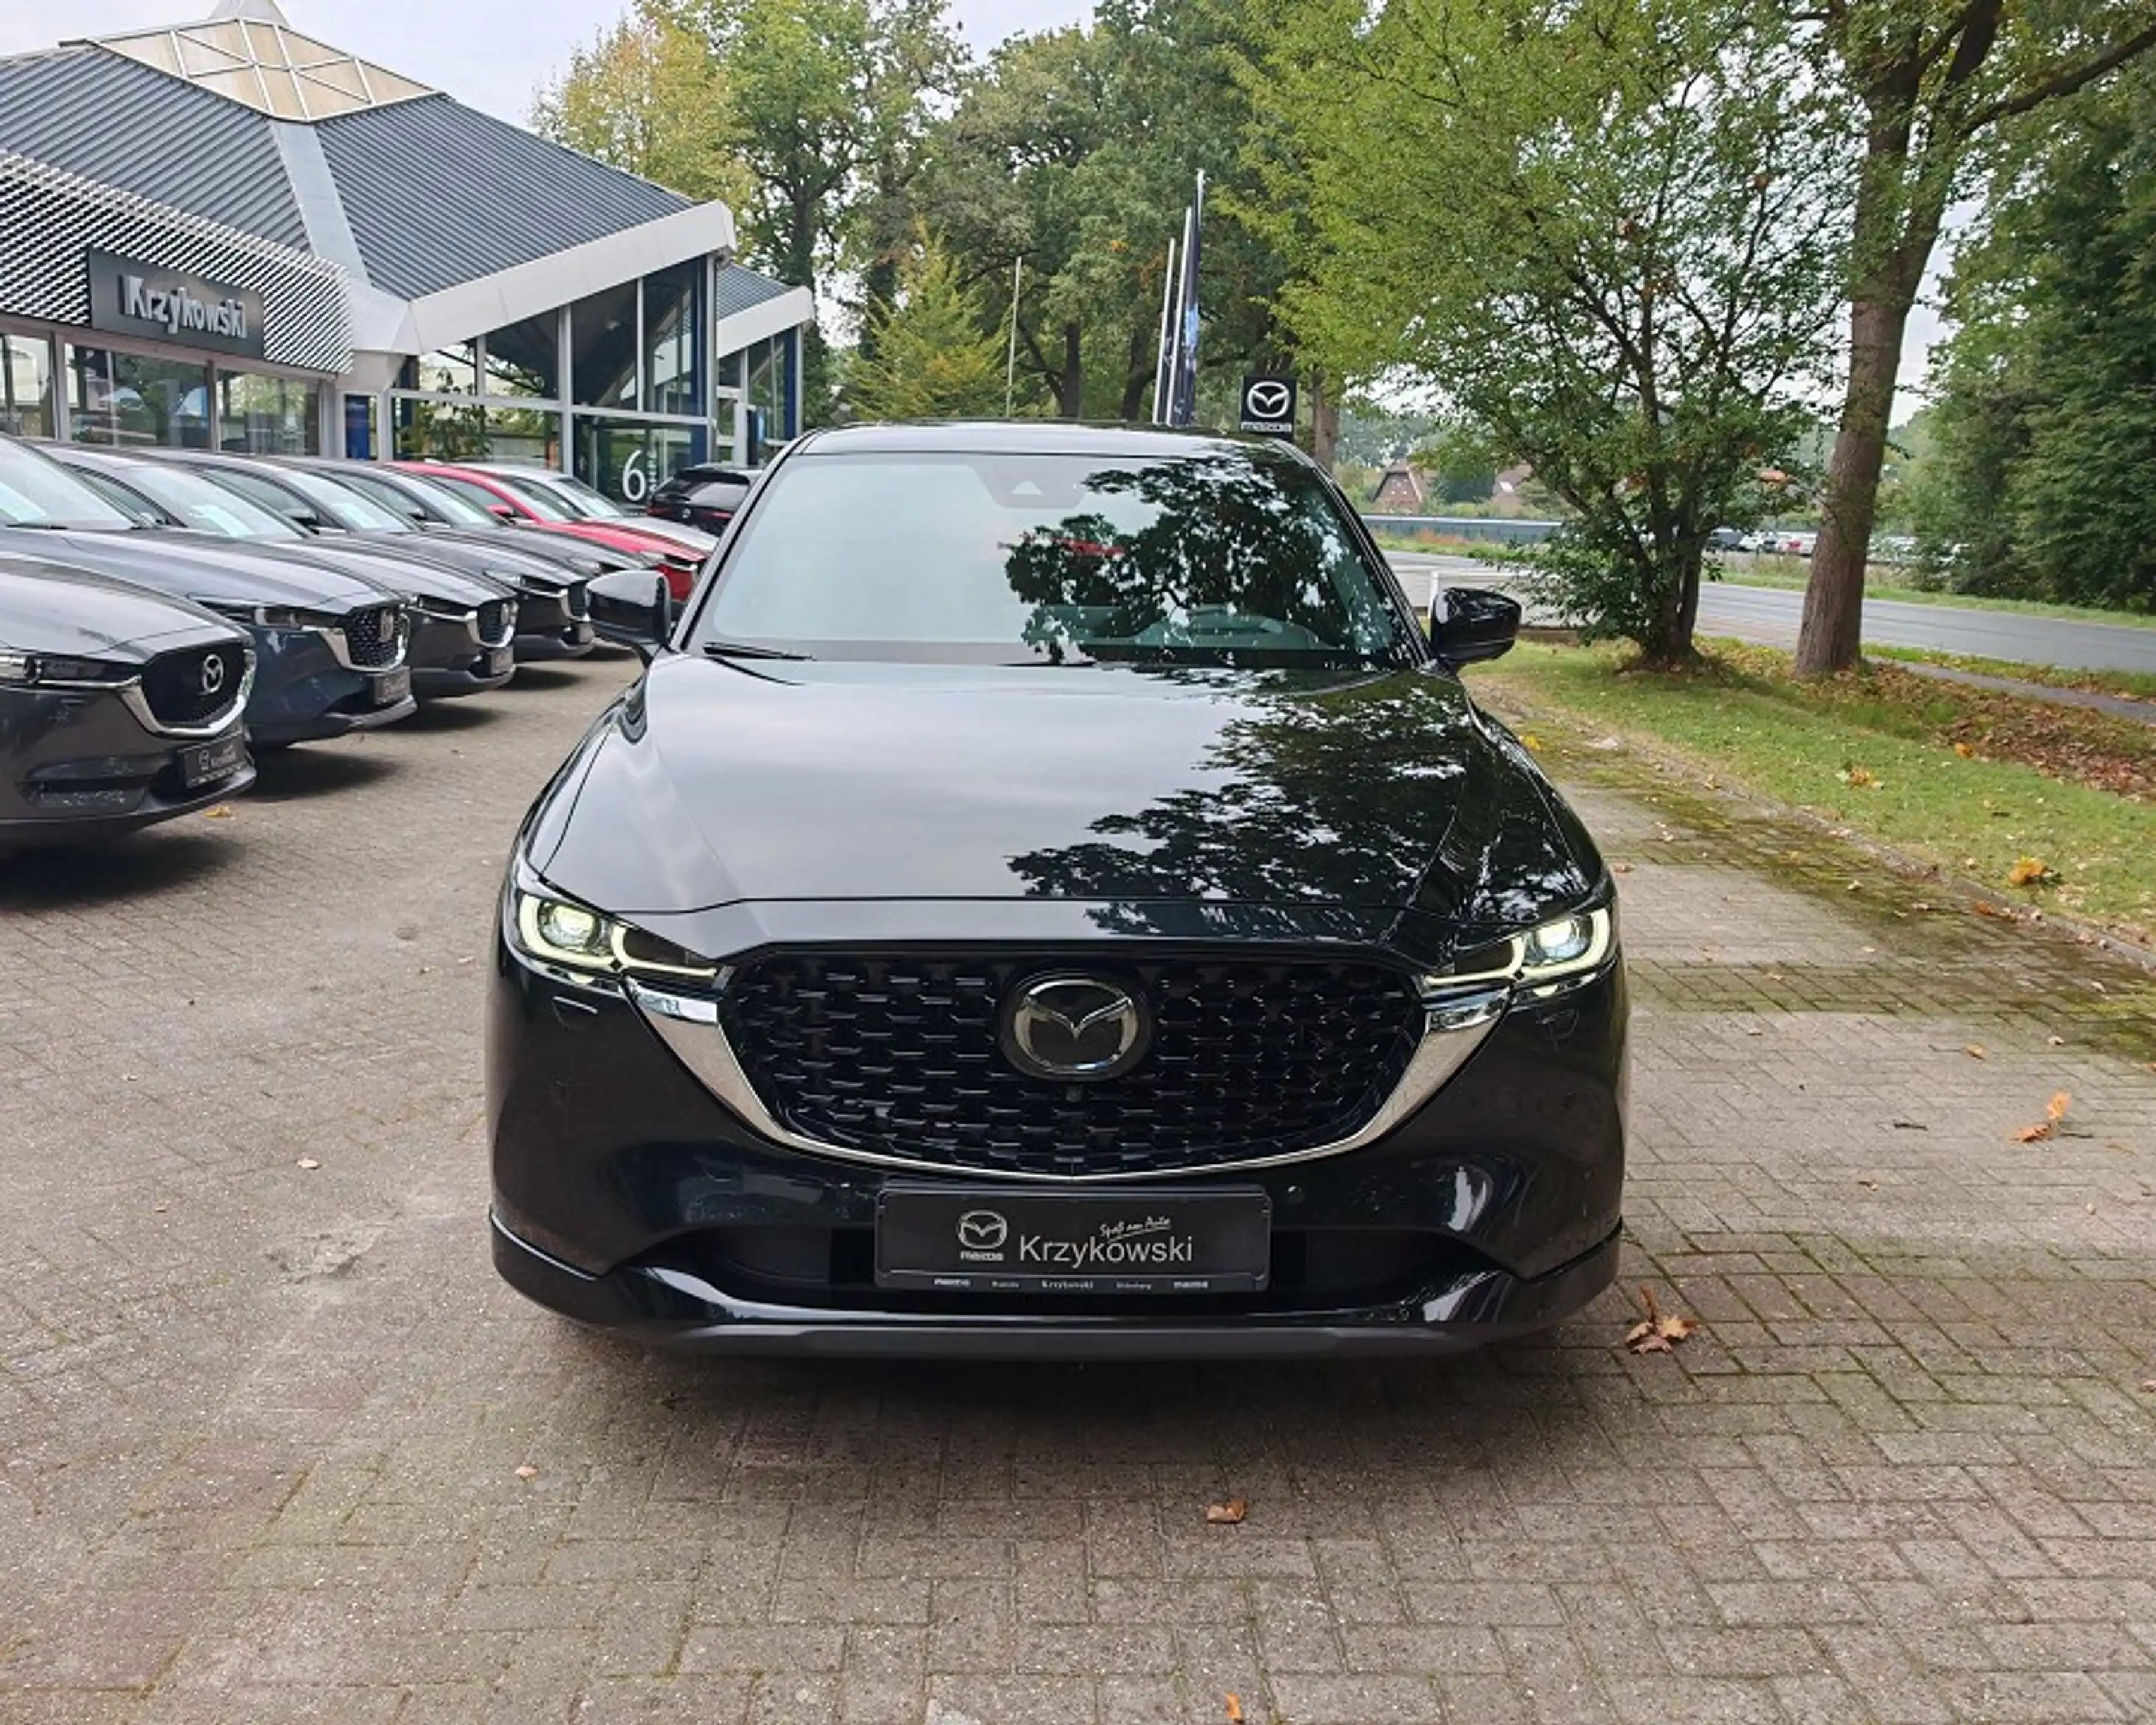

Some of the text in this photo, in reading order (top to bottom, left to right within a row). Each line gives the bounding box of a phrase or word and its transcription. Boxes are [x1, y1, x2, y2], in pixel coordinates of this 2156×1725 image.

[123, 274, 248, 338] Krzykowski
[623, 450, 646, 501] 6
[1019, 1235, 1192, 1268] Krzykowski
